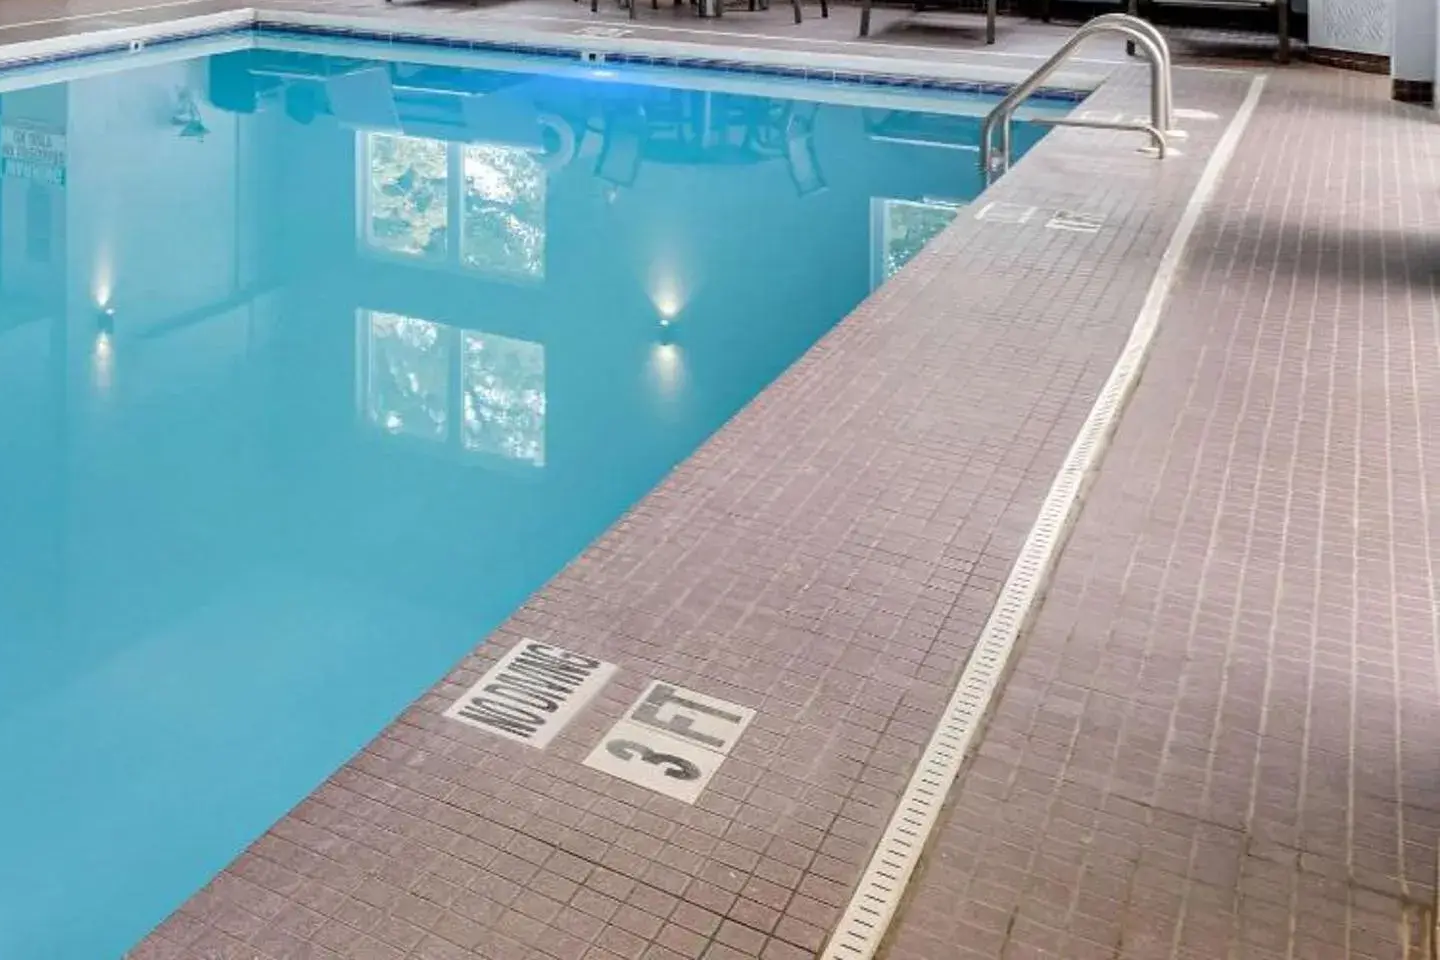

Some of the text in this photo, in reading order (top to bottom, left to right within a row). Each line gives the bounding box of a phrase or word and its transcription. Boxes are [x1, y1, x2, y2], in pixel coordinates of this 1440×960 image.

[457, 643, 601, 738] NO DIVING
[605, 683, 744, 781] 3 FT
